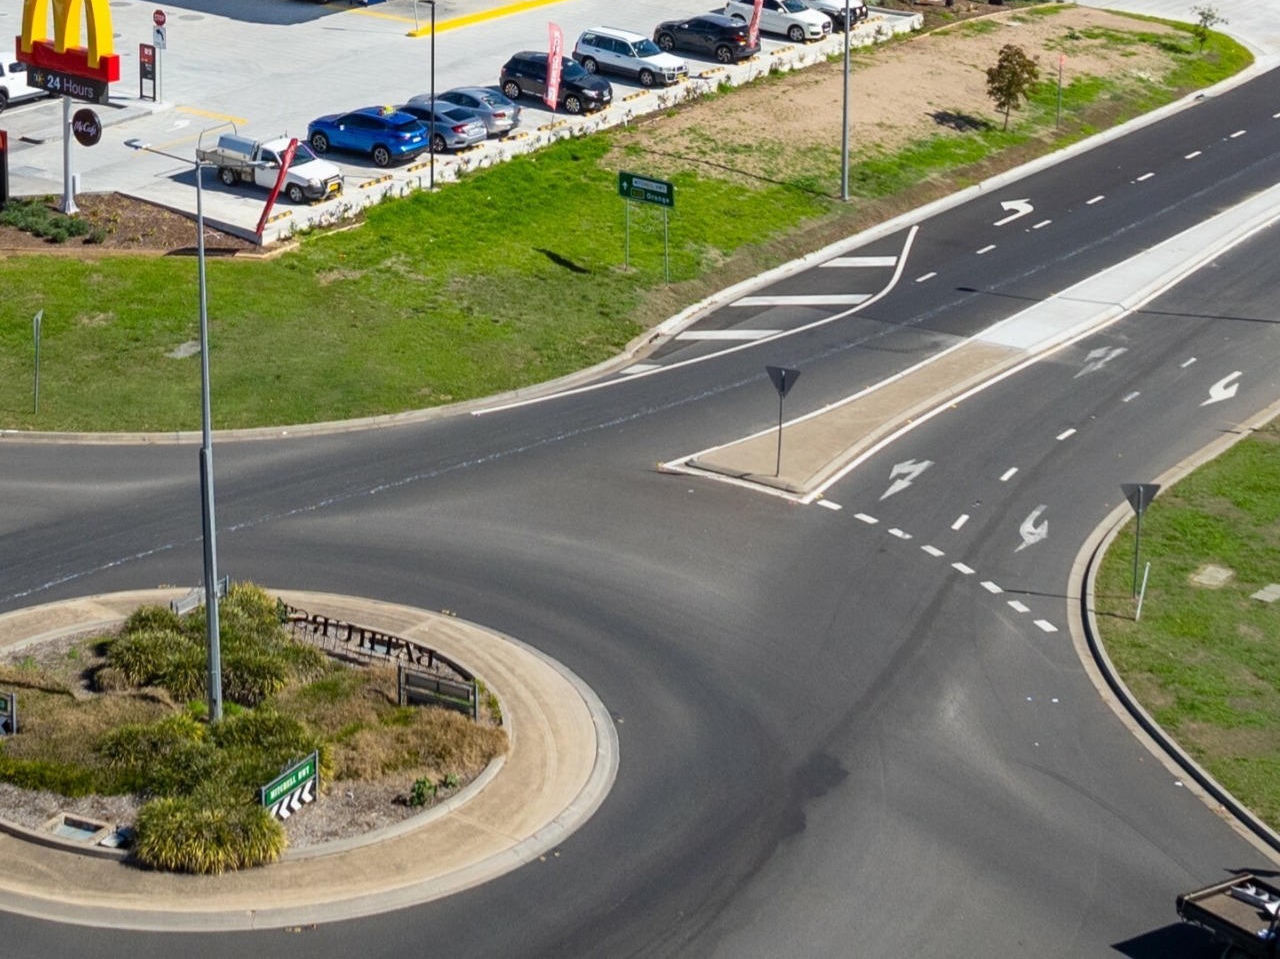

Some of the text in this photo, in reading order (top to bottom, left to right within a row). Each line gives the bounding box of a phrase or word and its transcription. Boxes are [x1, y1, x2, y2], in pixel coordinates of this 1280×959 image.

[47, 75, 94, 98] 24 Hours
[646, 192, 669, 204] Orange
[270, 765, 310, 799] MITCHELL HWY
